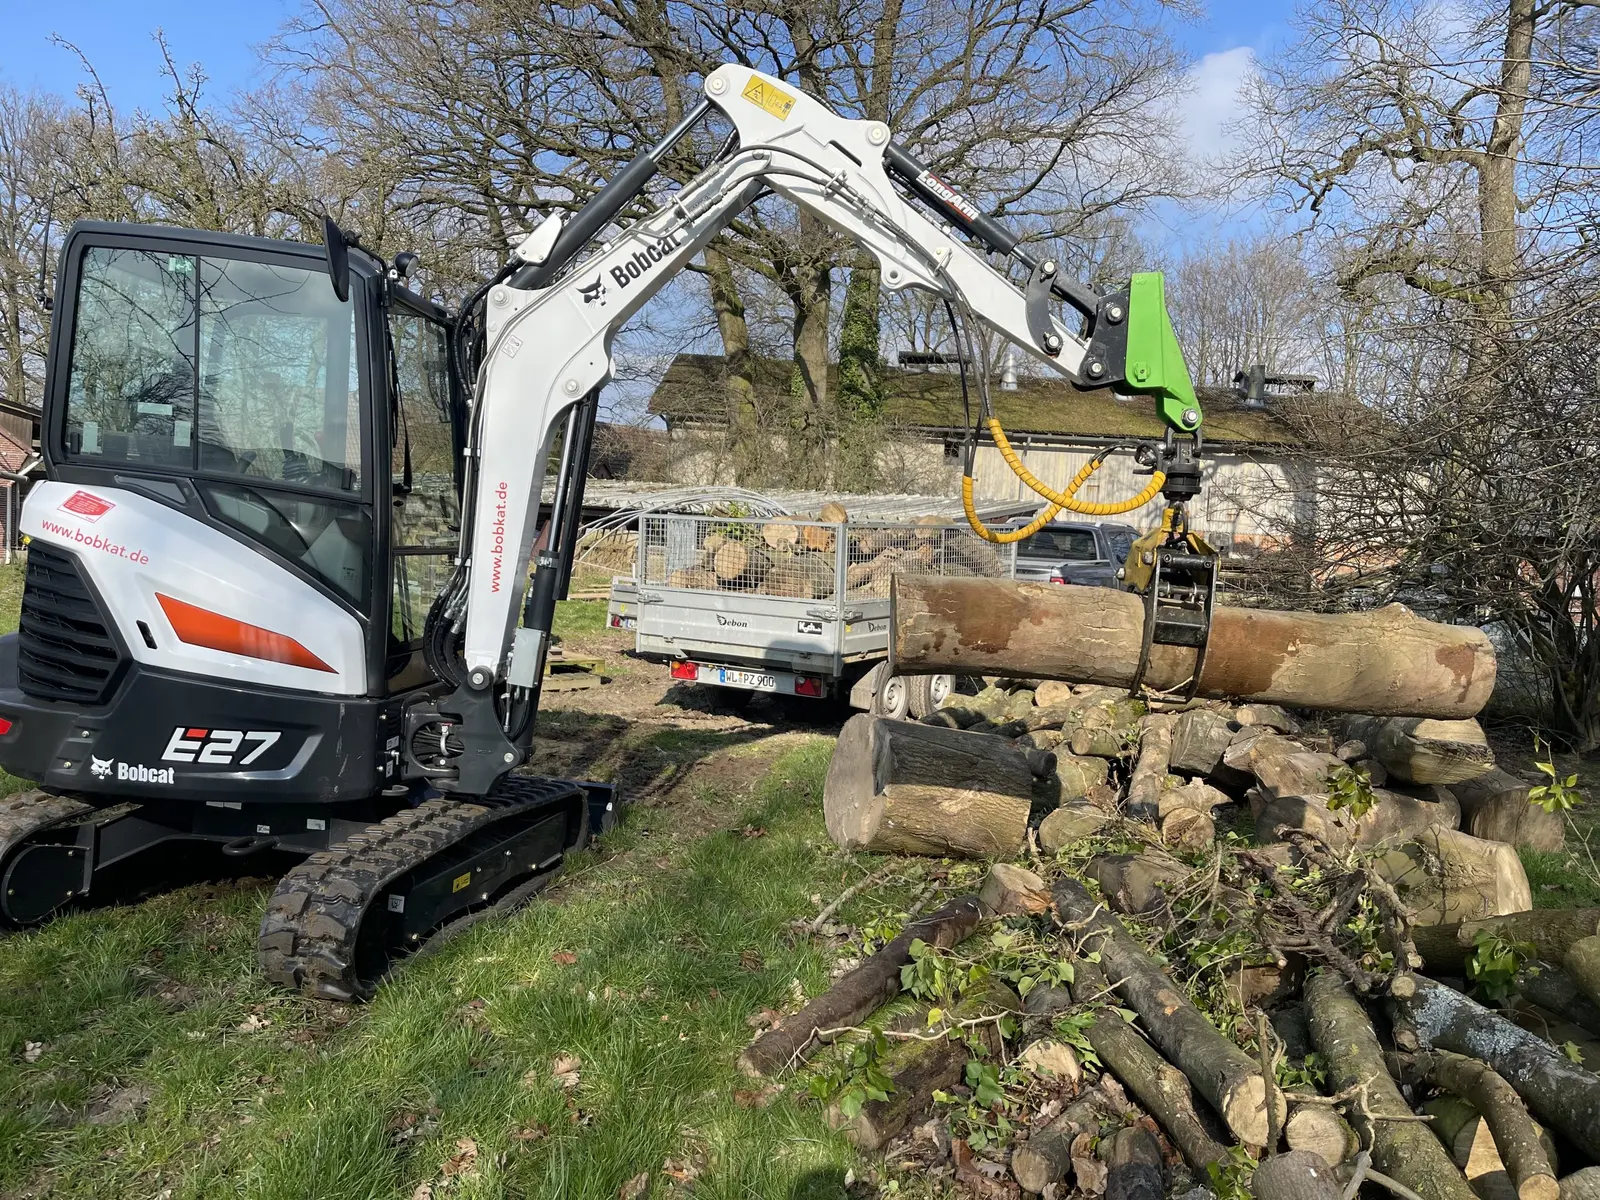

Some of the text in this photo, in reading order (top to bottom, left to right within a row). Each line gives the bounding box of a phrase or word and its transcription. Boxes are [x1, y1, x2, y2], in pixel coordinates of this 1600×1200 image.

[918, 170, 979, 220] LongArm
[609, 234, 682, 289] Bobcat
[41, 519, 149, 565] www.bobkat.de
[491, 482, 508, 593] www.bobkat.de
[716, 614, 748, 628] Debon
[726, 672, 775, 687] WL PZ 900
[160, 727, 282, 765] E27
[117, 762, 175, 784] Bobcat
